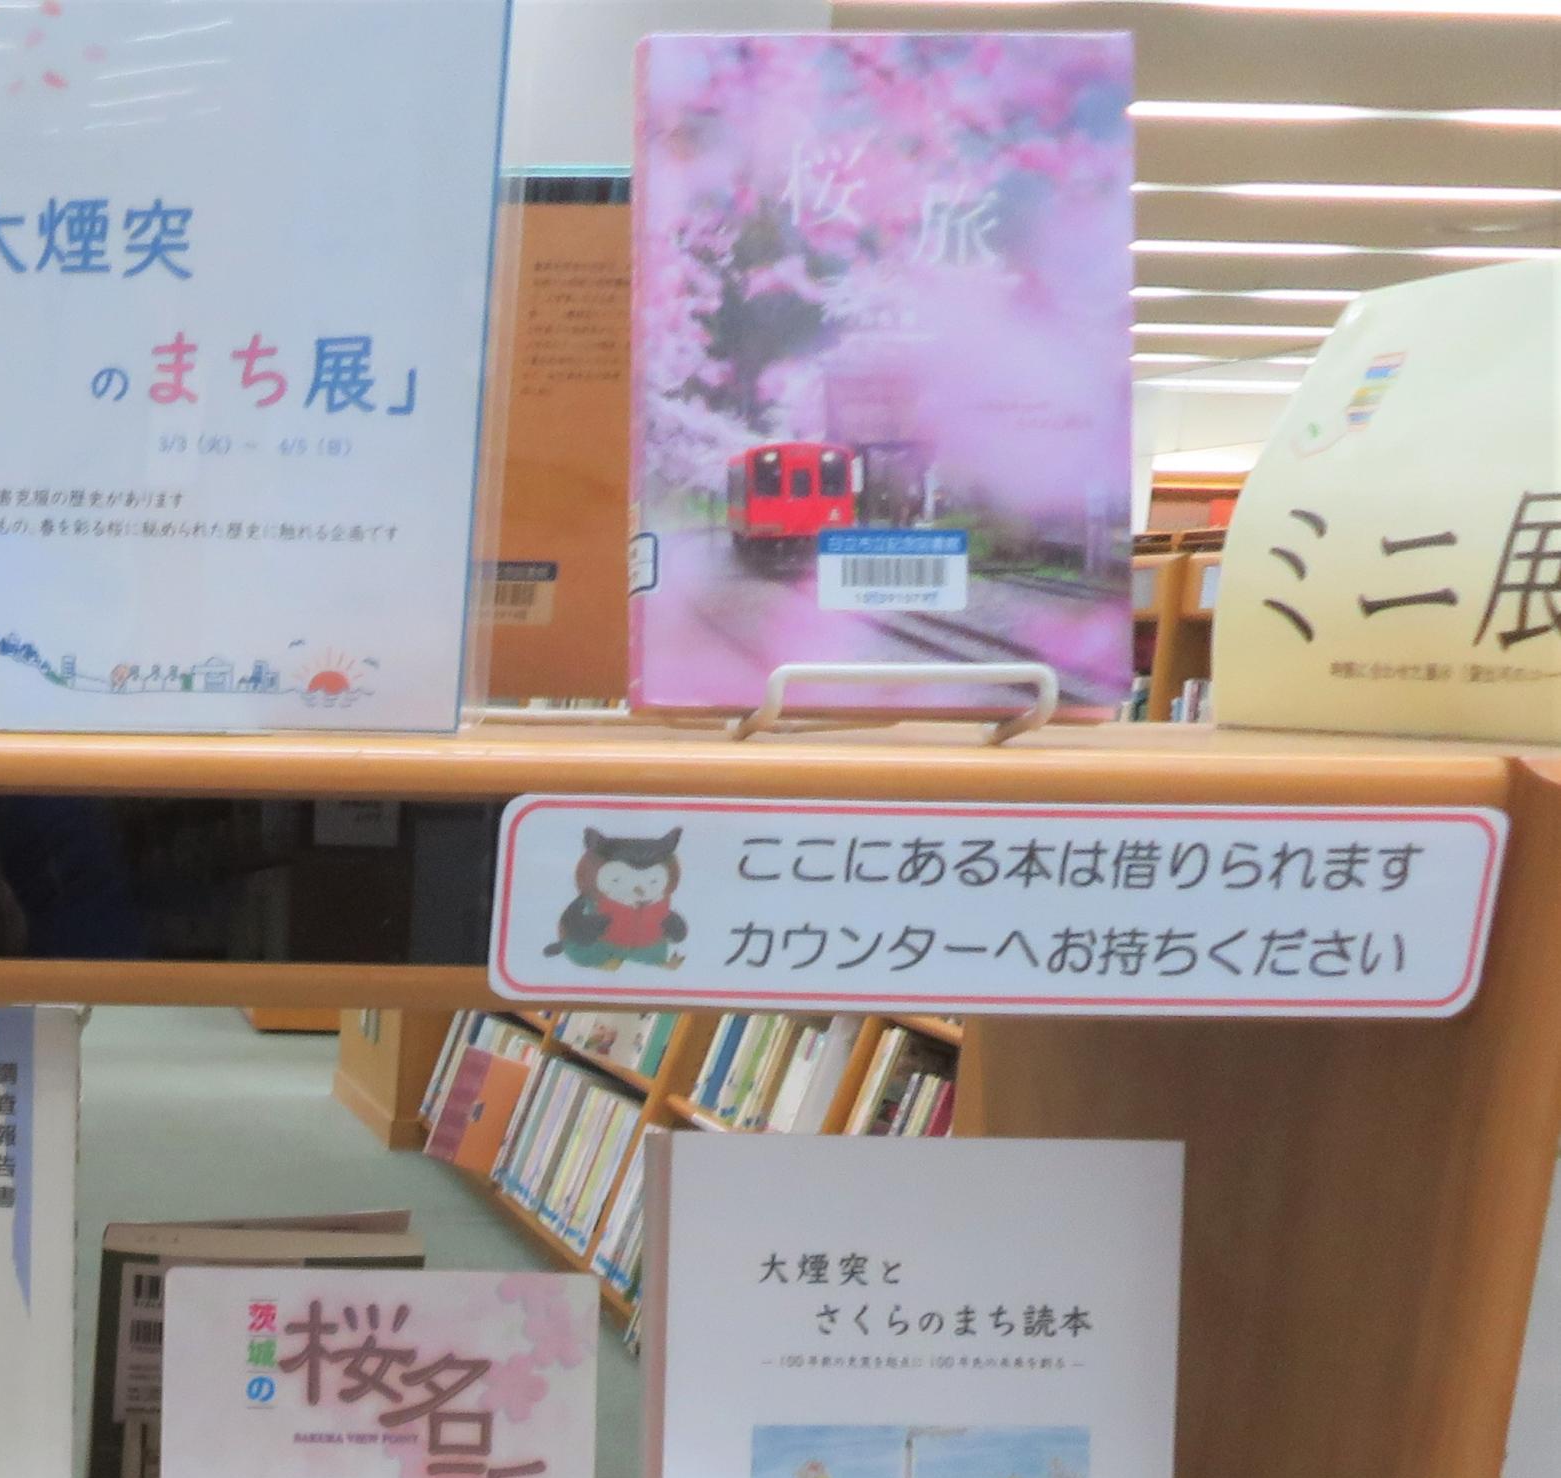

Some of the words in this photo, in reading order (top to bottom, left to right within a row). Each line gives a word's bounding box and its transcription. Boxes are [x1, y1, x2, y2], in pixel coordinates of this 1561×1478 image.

[738, 833, 1425, 893] ここにある本は借りられます
[724, 920, 1406, 979] カウンターへお持ちください
[757, 1251, 903, 1286] 大煙突と
[815, 1304, 1094, 1339] さくらのまち読本
